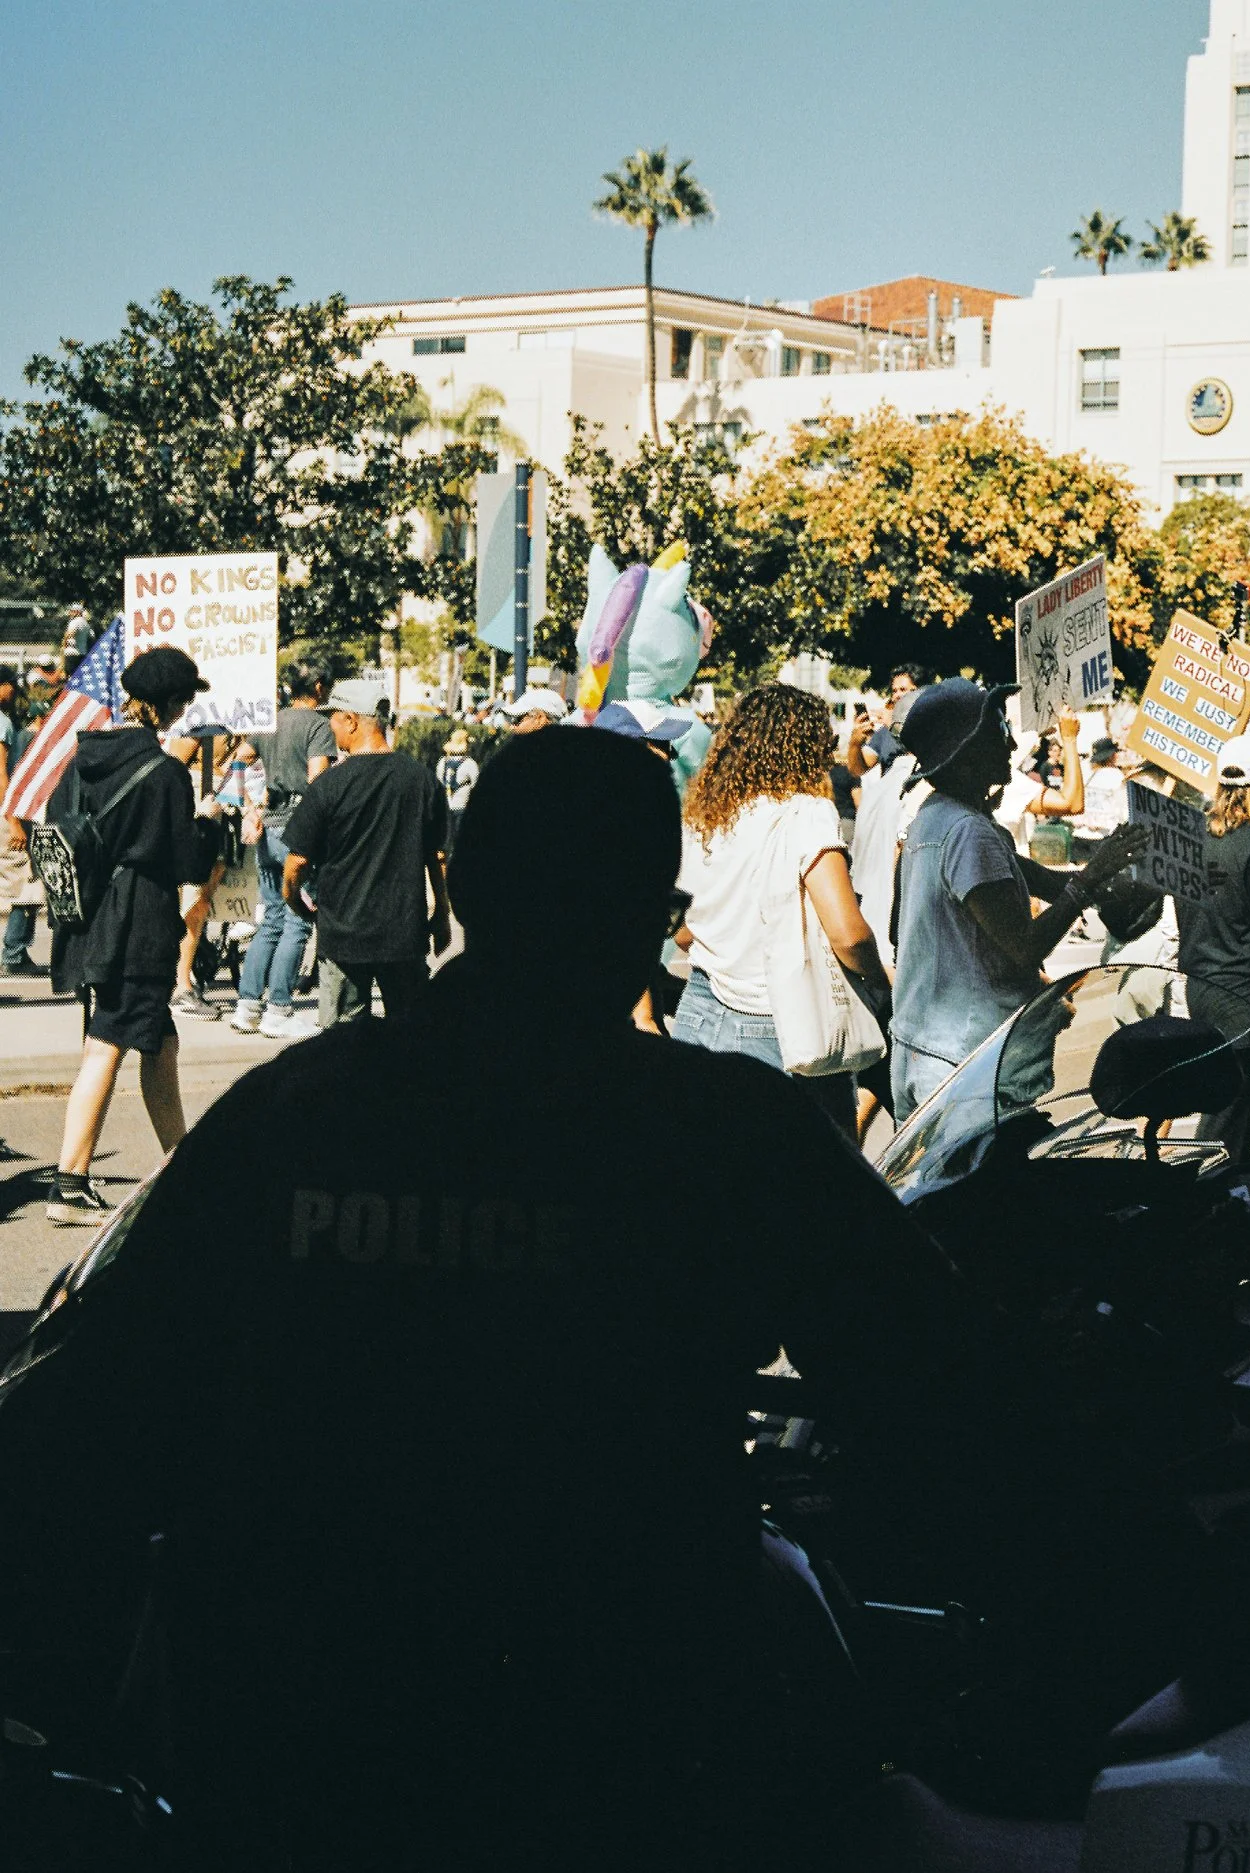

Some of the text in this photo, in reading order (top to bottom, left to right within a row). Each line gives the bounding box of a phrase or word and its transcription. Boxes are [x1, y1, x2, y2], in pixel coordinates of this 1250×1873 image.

[135, 564, 276, 599] NO KINGS
[1037, 562, 1105, 620] LADY LIBERTY
[133, 600, 276, 638] NO CROWNS
[1062, 597, 1107, 657] SENT
[187, 631, 274, 661] FASCIST
[1172, 624, 1222, 663] WE'RE
[1081, 650, 1110, 699] ME
[1174, 655, 1241, 703] RADICAL
[183, 696, 274, 732] OWNS
[1163, 678, 1237, 731] WE JUST
[1144, 728, 1211, 777] HISTORY
[1135, 784, 1160, 818] NO
[1151, 821, 1204, 871] WITH
[290, 1188, 575, 1270] POLICE
